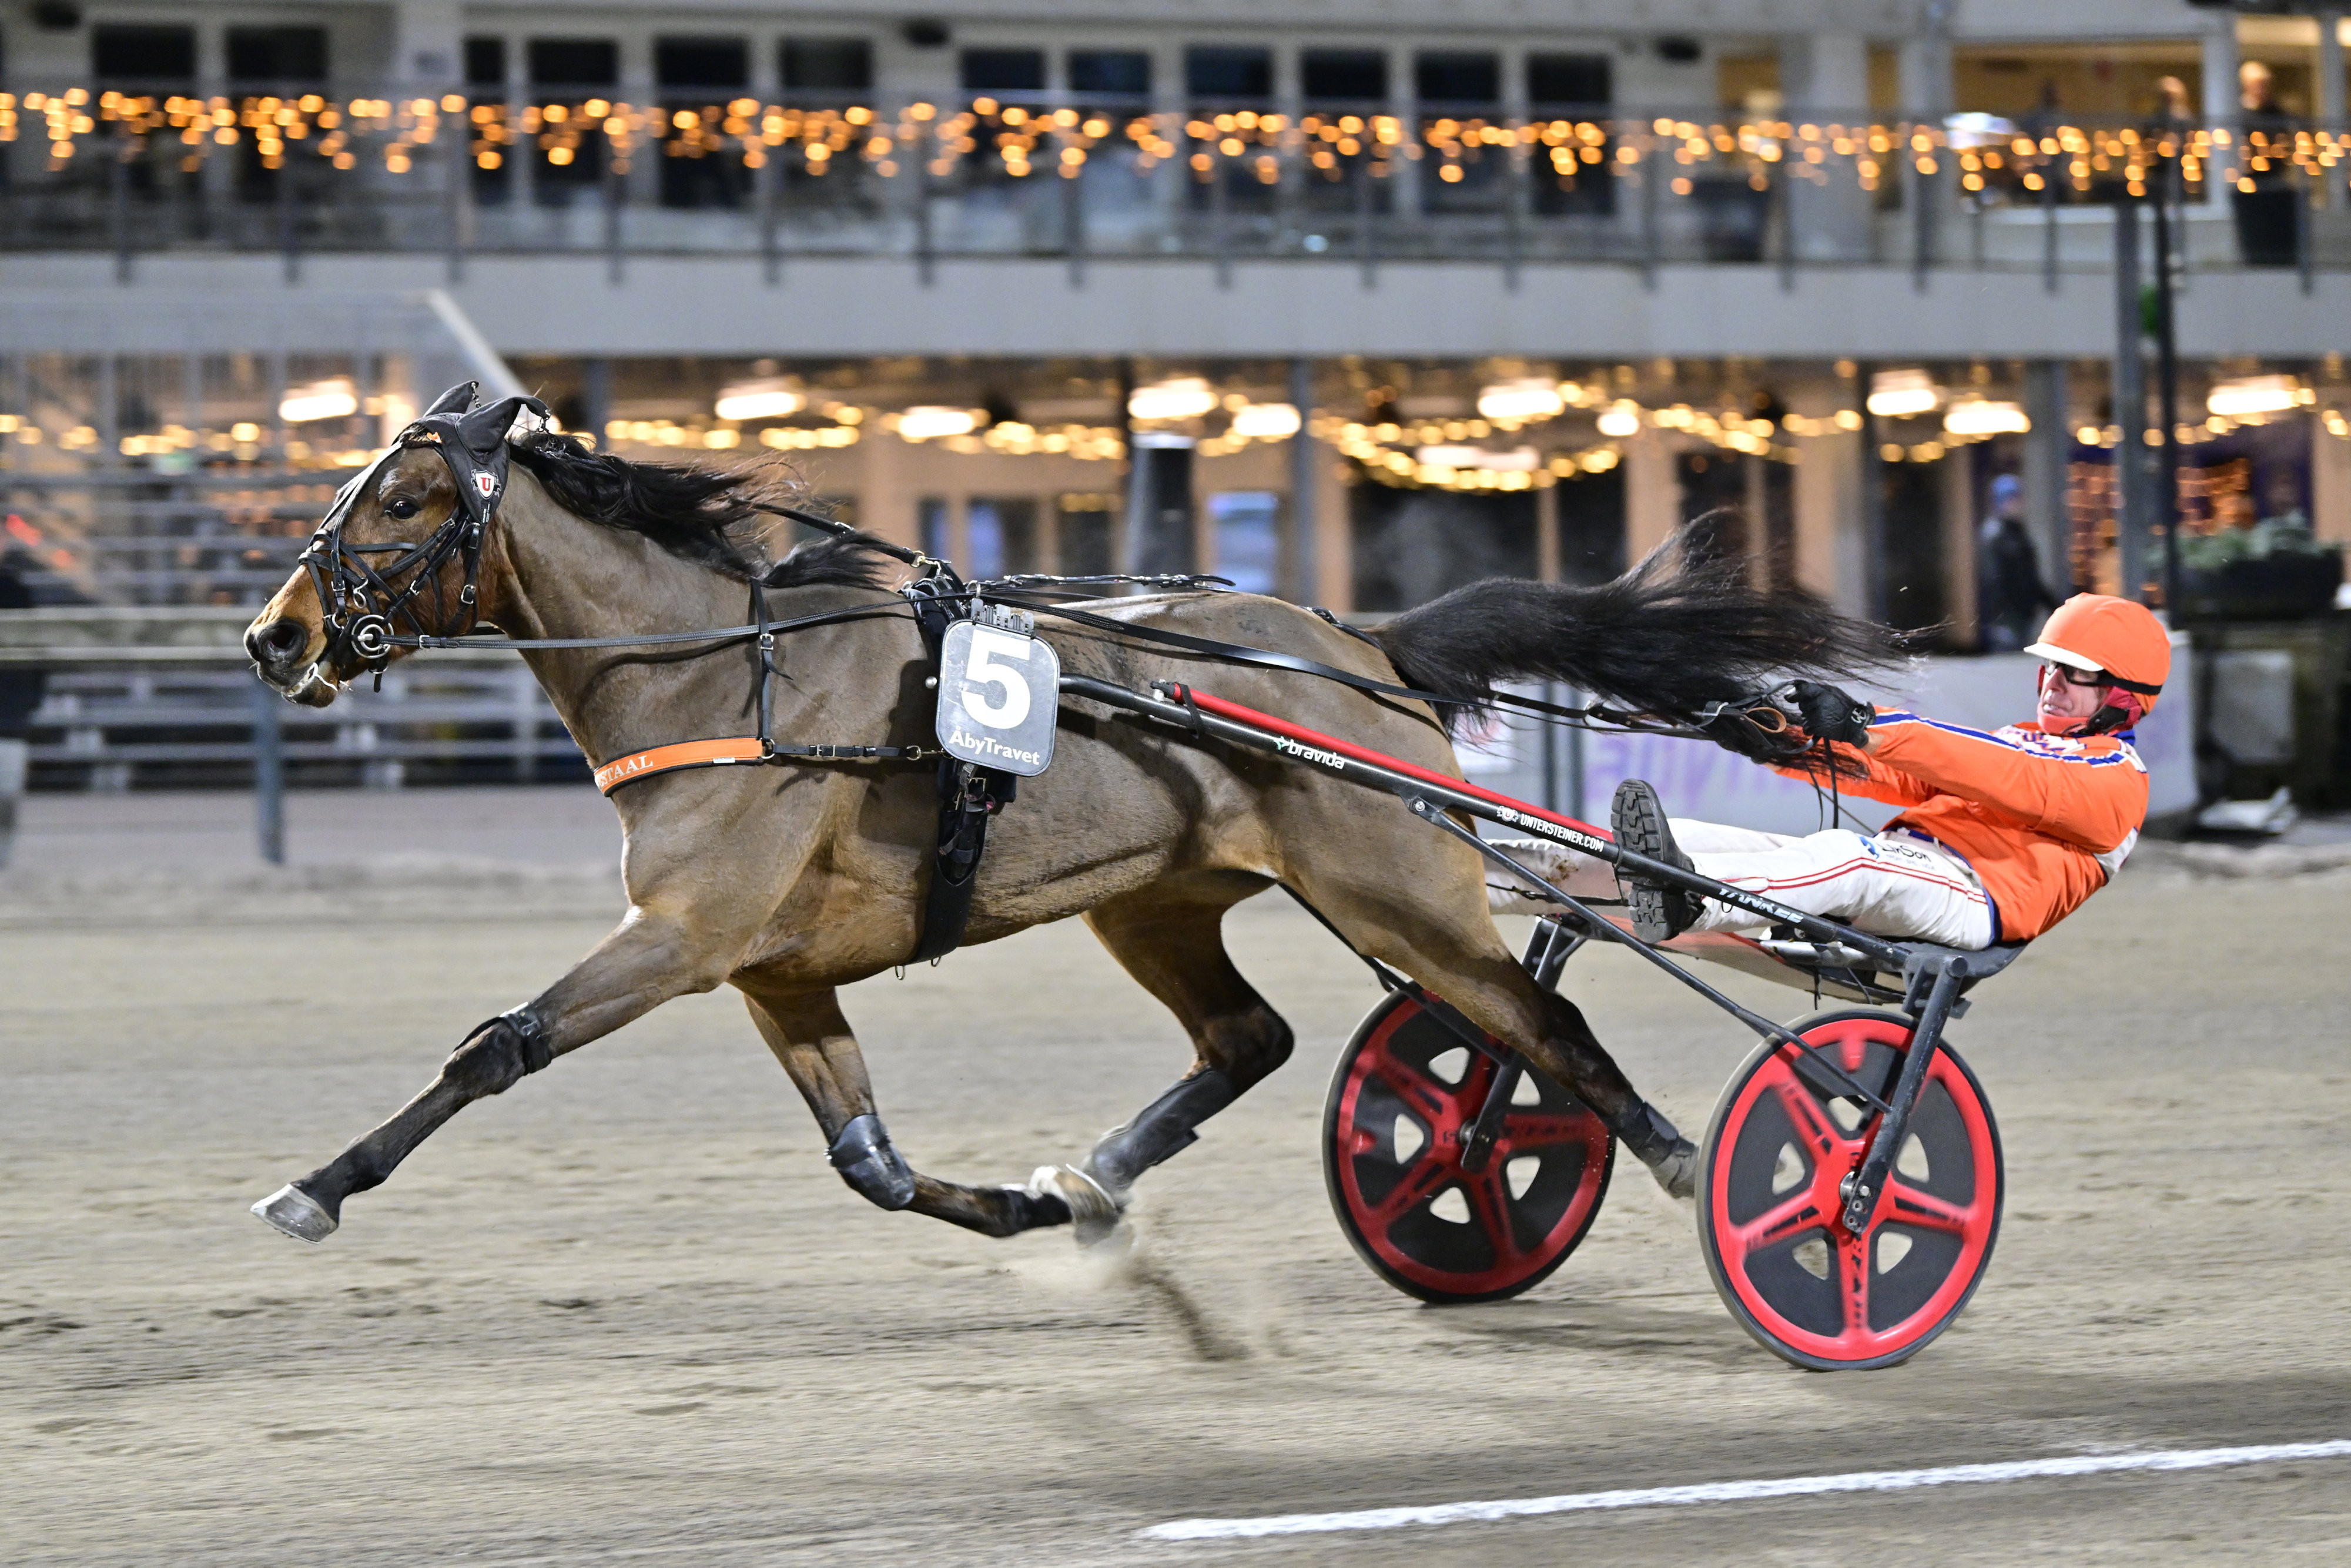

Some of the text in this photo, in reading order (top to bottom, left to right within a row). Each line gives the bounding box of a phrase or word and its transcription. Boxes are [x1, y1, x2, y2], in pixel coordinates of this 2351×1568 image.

[481, 477, 491, 491] U
[960, 629, 1031, 729] 5
[949, 726, 1040, 765] ÅbyTravet
[1288, 739, 1345, 769] bravida
[595, 755, 654, 788] STAAL
[1521, 813, 1605, 852] UNTERSTEINER.COM
